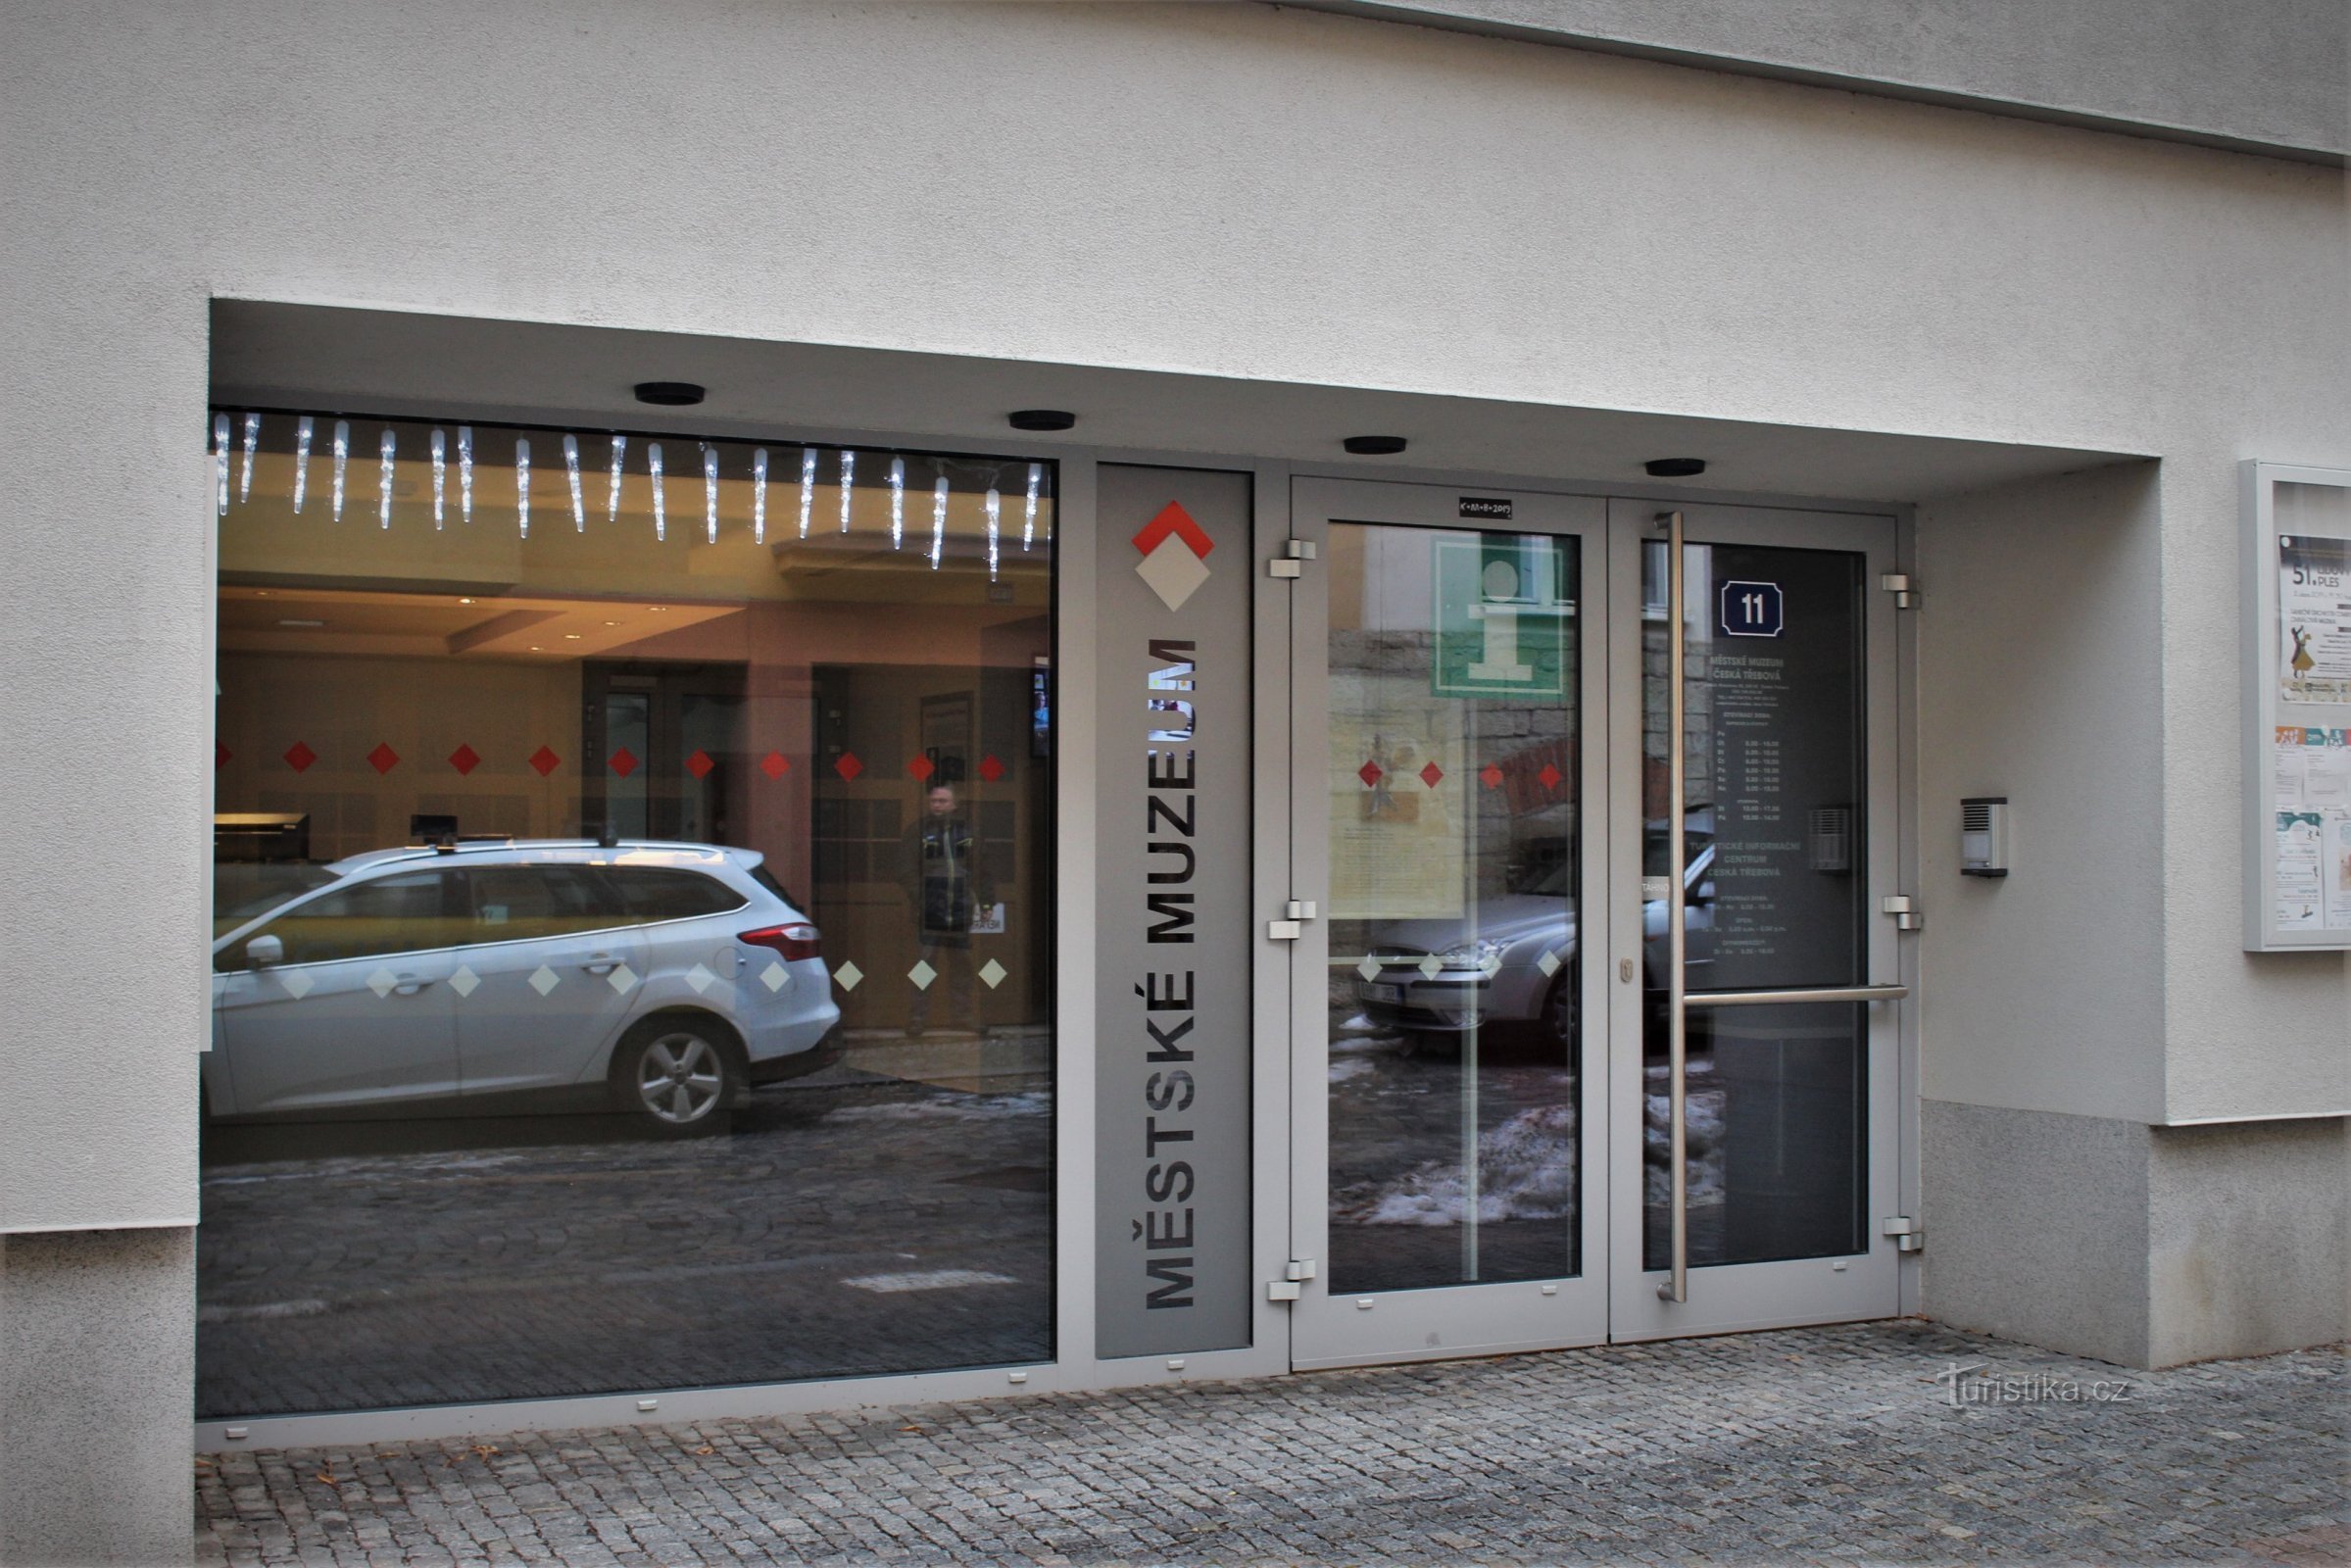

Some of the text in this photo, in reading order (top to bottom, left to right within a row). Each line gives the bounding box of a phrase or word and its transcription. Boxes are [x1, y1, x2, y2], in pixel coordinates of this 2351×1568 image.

[2318, 576, 2339, 588] PLES
[1741, 593, 1764, 624] 11
[1709, 654, 1785, 667] MĚSTSKÉ MUZEUM
[1712, 667, 1782, 681] ČESKÁ TŘEBOVÁ
[1690, 841, 1743, 851] TURTICKÉ
[1724, 855, 1768, 863] CENTRUM
[1641, 882, 1669, 892] TÁHNO
[1132, 638, 1197, 1310] MĚSTSKÉ MUZEUM
